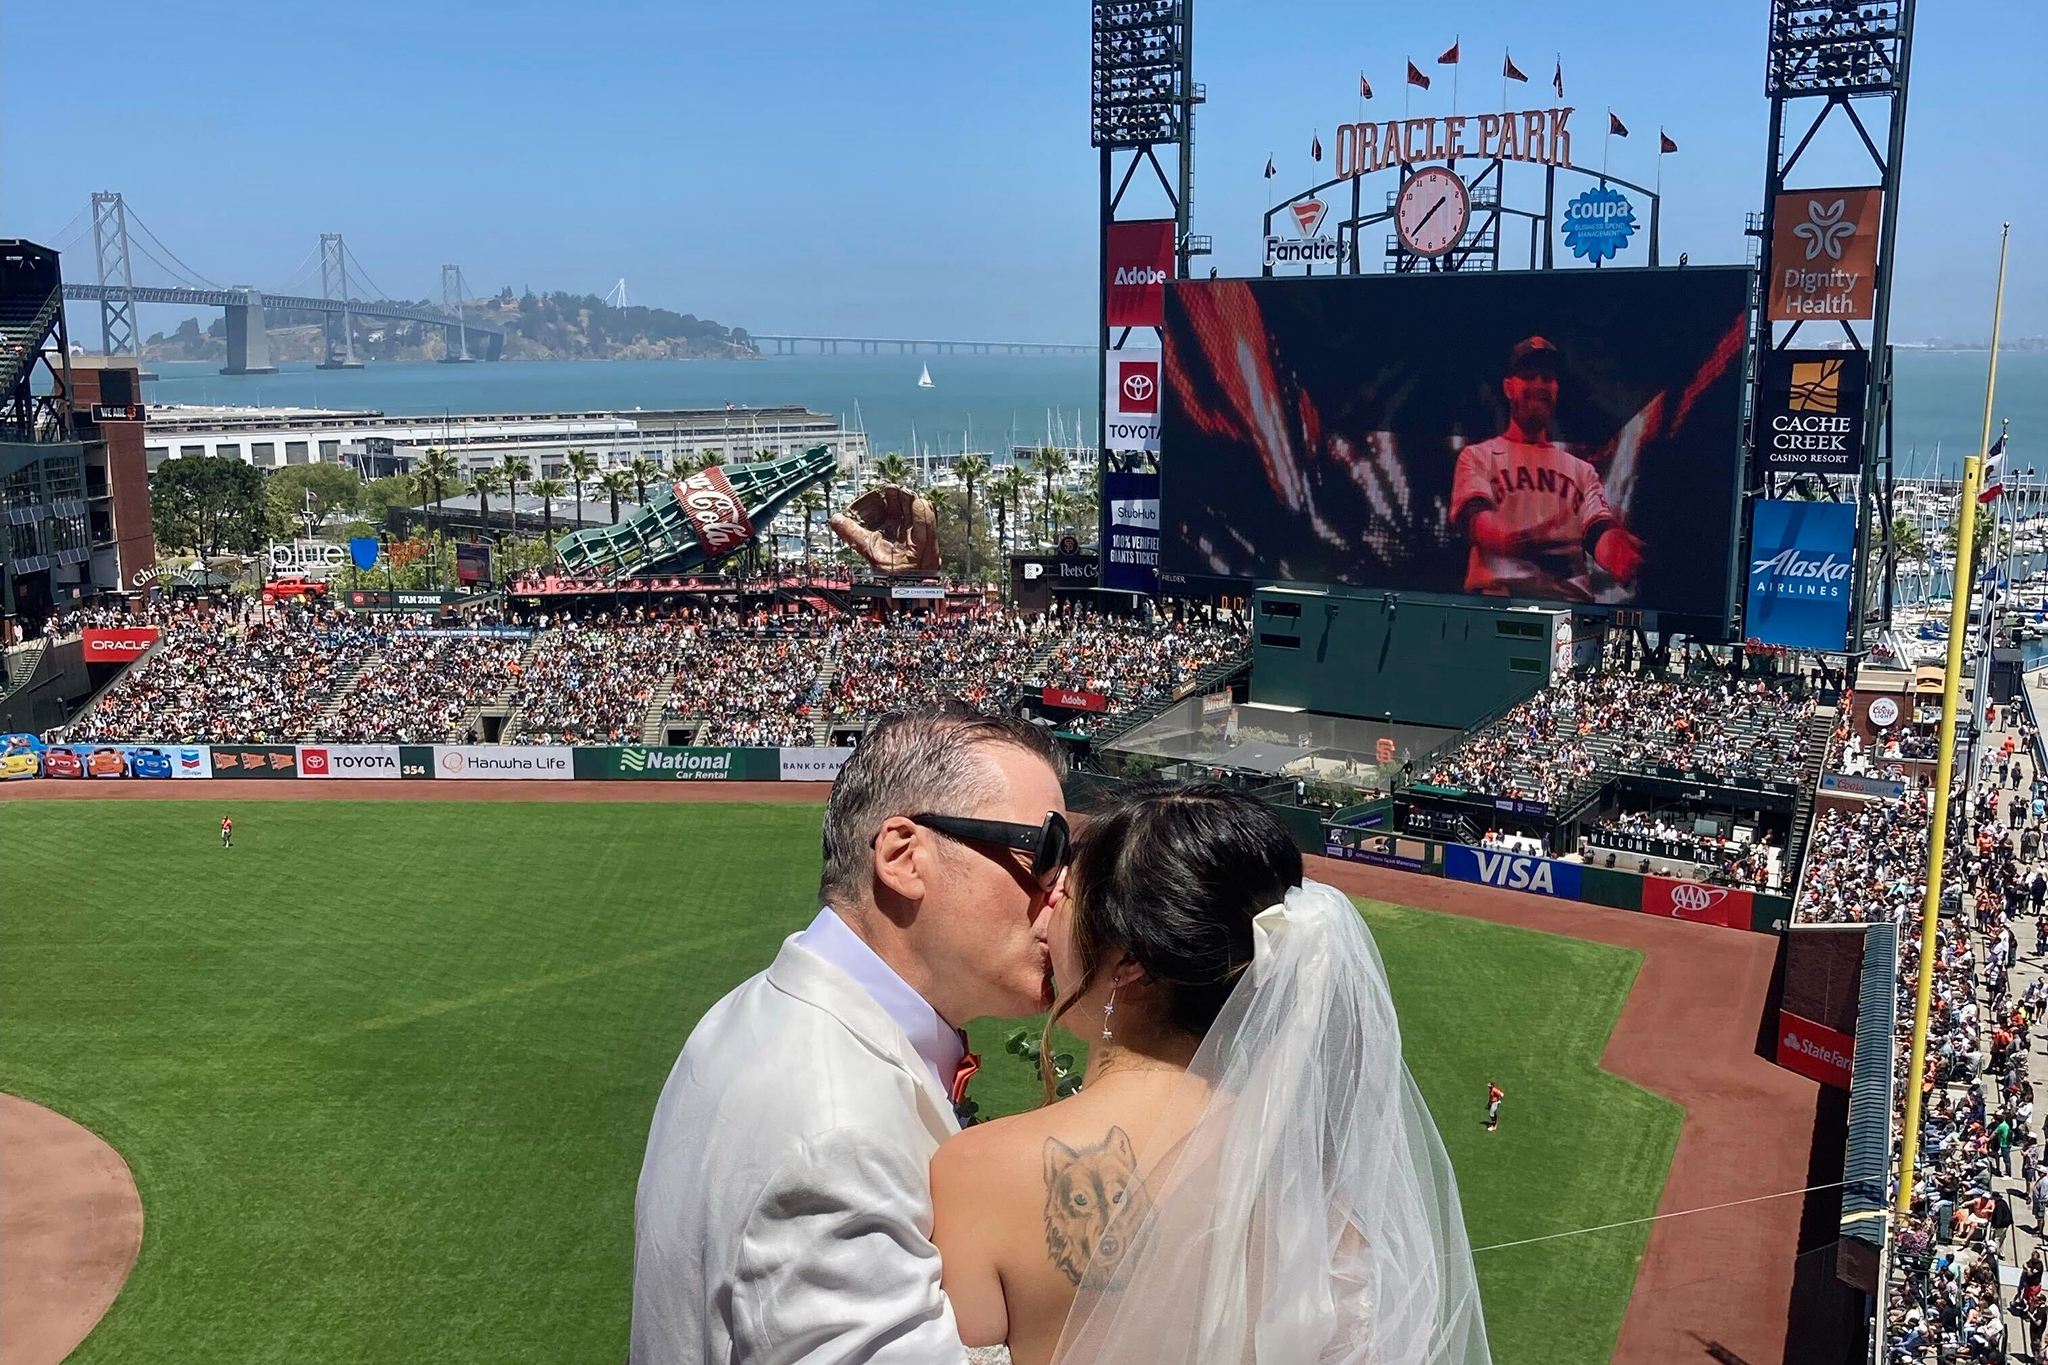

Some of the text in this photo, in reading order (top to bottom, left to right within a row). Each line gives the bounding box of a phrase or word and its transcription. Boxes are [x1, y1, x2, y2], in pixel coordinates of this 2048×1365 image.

[1336, 107, 1574, 180] ORACLE PARK
[1429, 174, 1437, 182] 12
[1458, 207, 1462, 215] 3
[1571, 201, 1628, 223] coupa
[1405, 226, 1409, 234] 8
[1453, 224, 1457, 232] 4
[1605, 222, 1625, 230] SPEND
[1114, 266, 1166, 285] Adobe
[1784, 268, 1858, 293] Dignity
[1786, 293, 1853, 314] Health
[100, 407, 112, 417] WE
[113, 407, 126, 417] ARE
[1772, 415, 1851, 432] CACHE
[1773, 433, 1847, 450] CREEK
[1769, 453, 1848, 463] CASINO RESORT
[1118, 507, 1156, 519] StubHub
[1112, 534, 1130, 549] 100%
[269, 537, 344, 567] blue
[1110, 549, 1135, 564] GIANTS
[1060, 563, 1083, 577] Peet's
[1752, 548, 1850, 583] Alaska
[1757, 582, 1838, 596] AIRLINES
[399, 595, 417, 604] FAN
[418, 595, 441, 604] ZONE
[91, 640, 151, 650] ORACLE
[1061, 694, 1087, 706] Adobe
[334, 756, 395, 768] TOYOTA
[468, 757, 565, 769] Hanwha Life
[647, 752, 731, 769] National
[783, 762, 810, 770] BANK
[403, 765, 426, 775] 354
[676, 771, 728, 779] Car Rental
[1591, 833, 1715, 862] WELCOME TO THE
[1470, 850, 1553, 894] VISA
[1674, 884, 1708, 911] AAA
